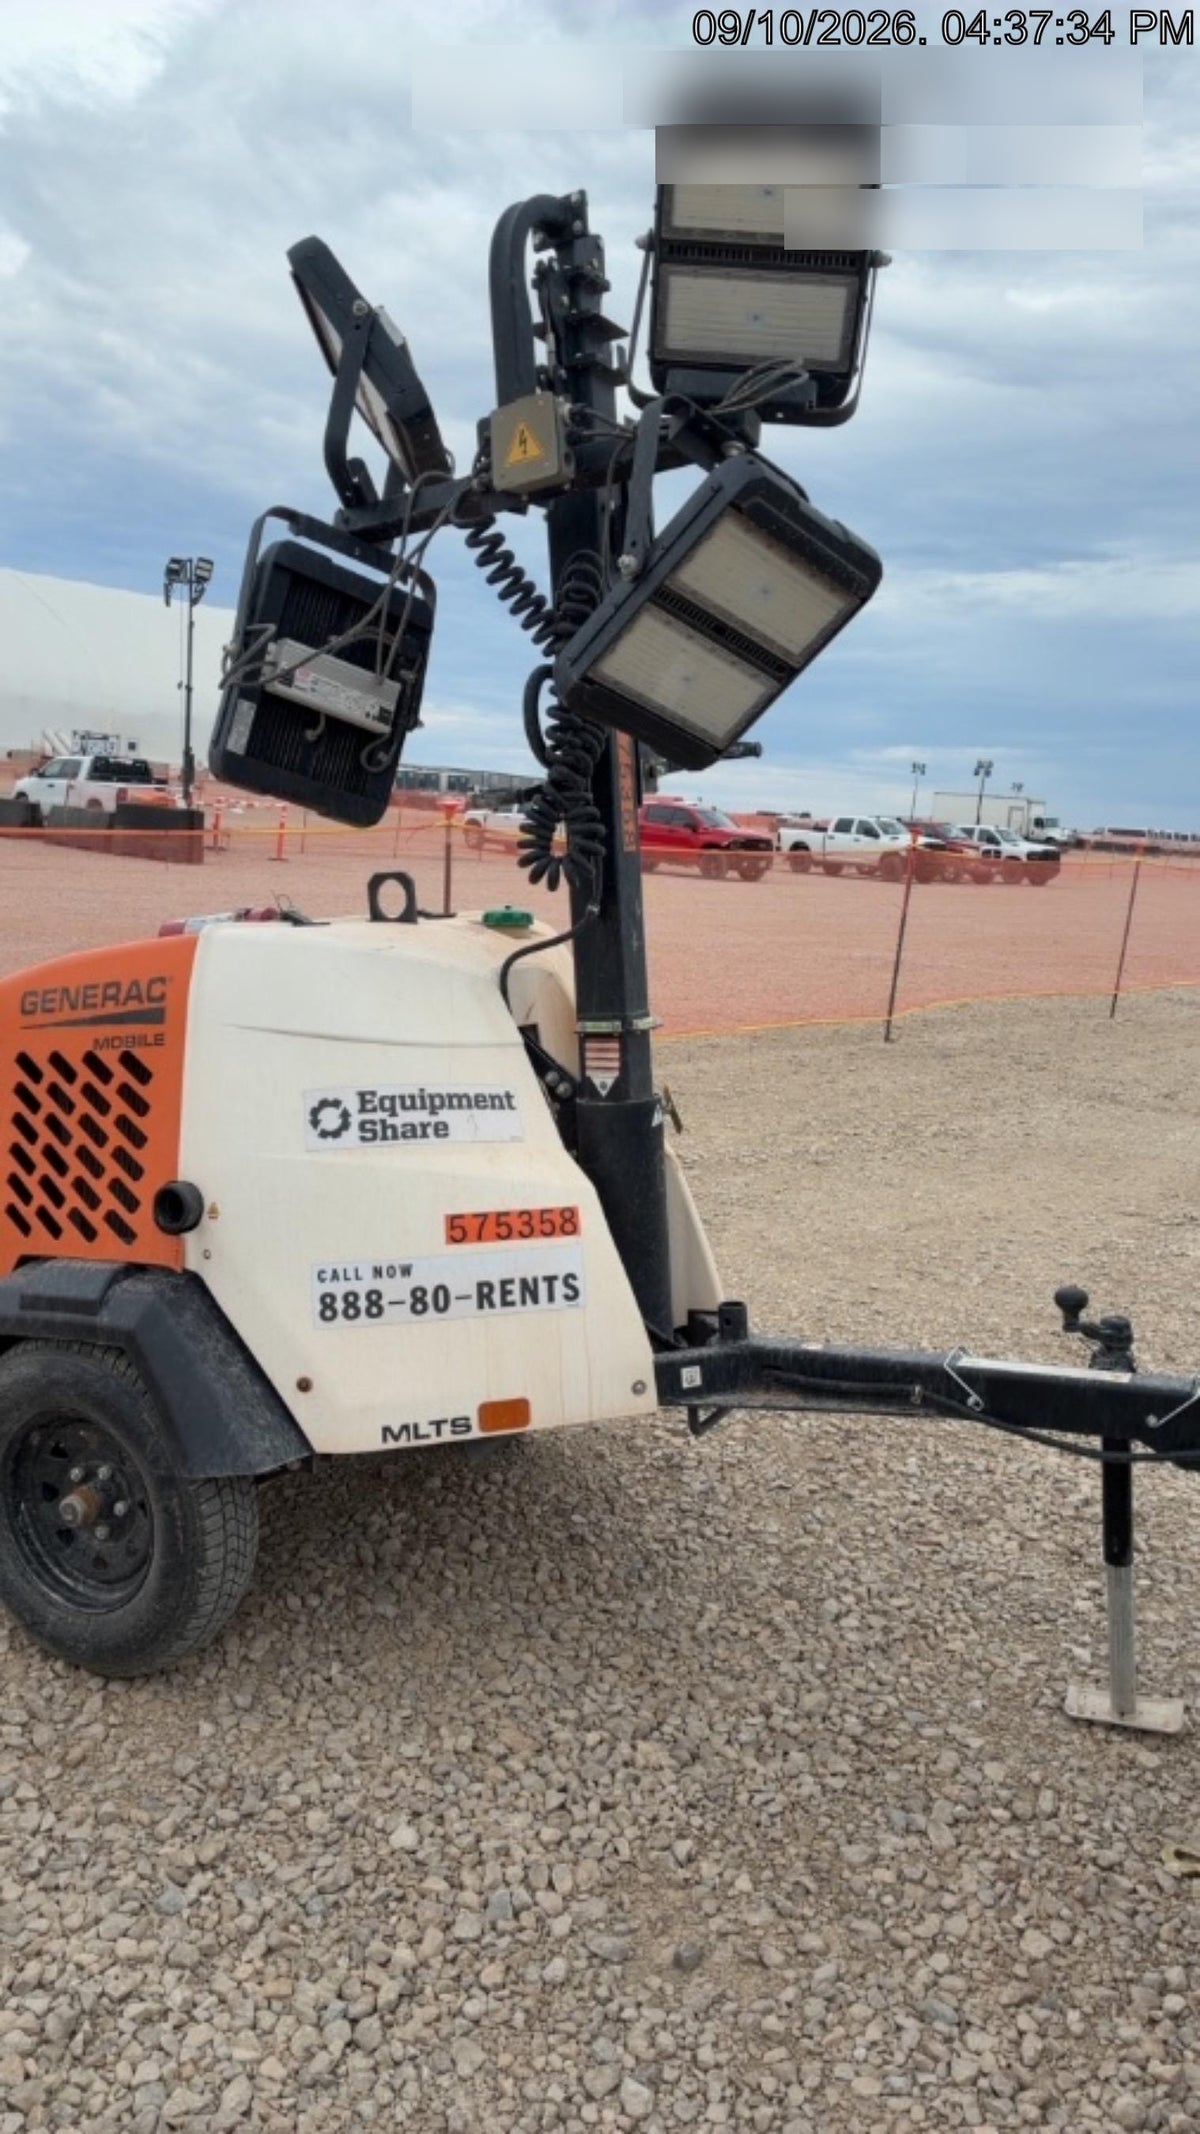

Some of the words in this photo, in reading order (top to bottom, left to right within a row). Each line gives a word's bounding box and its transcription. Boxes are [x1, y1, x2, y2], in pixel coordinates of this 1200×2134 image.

[20, 976, 167, 1016] GENERAC
[93, 1033, 165, 1050] MOBILE
[357, 1088, 517, 1117] Equipment
[358, 1118, 449, 1142] Share
[449, 1207, 578, 1243] 575358
[317, 1267, 363, 1284] CALL
[372, 1263, 413, 1279] NOW
[319, 1273, 580, 1322] 888-80-RENTS
[381, 1416, 472, 1444] MLTS
